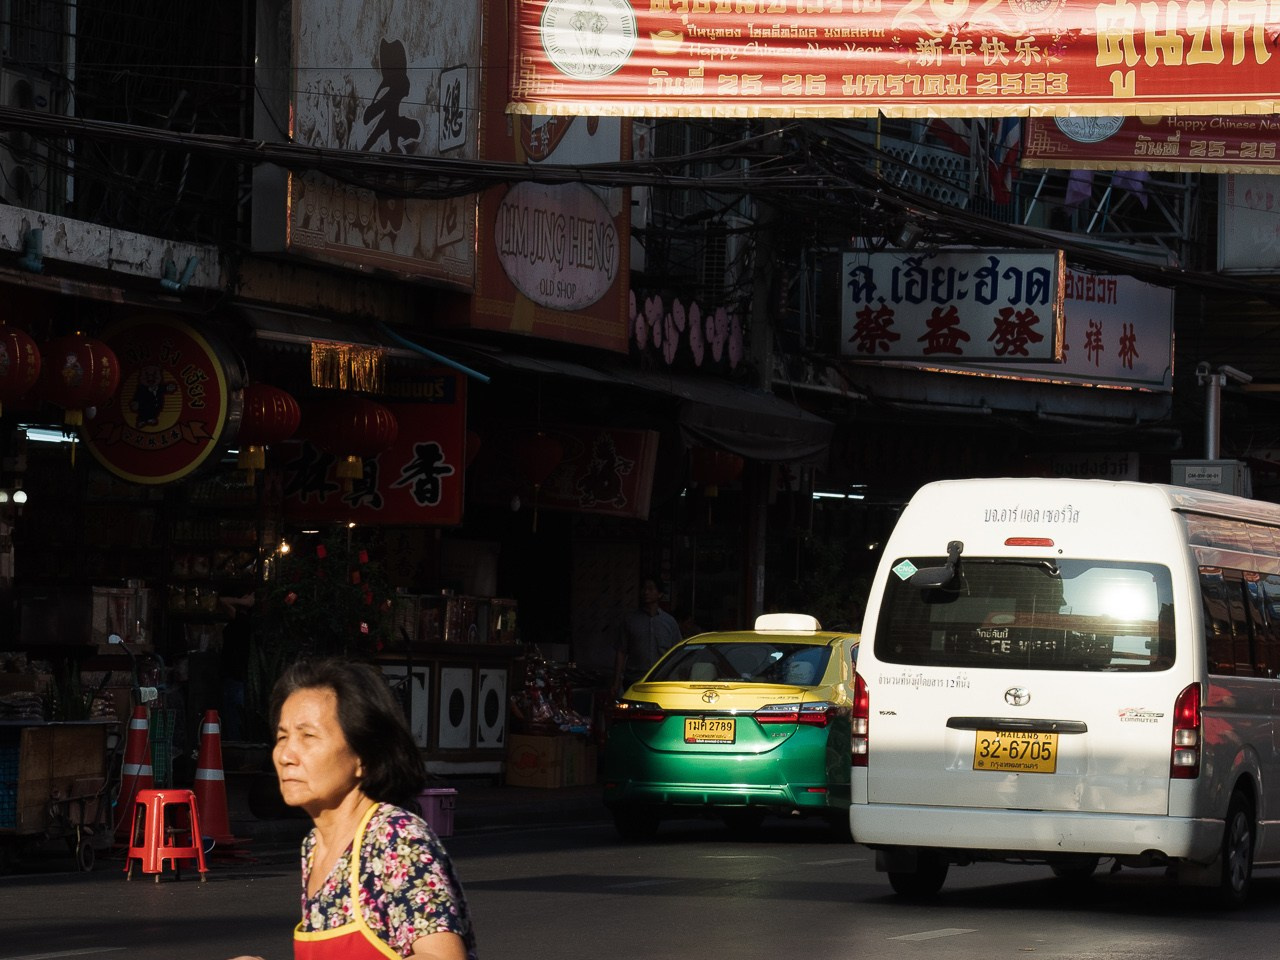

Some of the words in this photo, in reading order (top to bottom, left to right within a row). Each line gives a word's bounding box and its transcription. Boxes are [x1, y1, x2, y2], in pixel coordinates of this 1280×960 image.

[689, 43, 738, 60] Happy
[741, 42, 803, 57] Chinese
[806, 43, 842, 58] New
[844, 43, 883, 58] Year
[915, 36, 1041, 67] 新年快乐
[648, 60, 705, 97] วันที่
[717, 74, 827, 96] 25-26
[841, 74, 968, 96] มกราคม
[976, 73, 1069, 95] 2563
[1167, 116, 1207, 131] Happy
[1212, 117, 1256, 131] Chinese
[1133, 130, 1181, 156] วันที่
[1188, 140, 1276, 159] 25-26
[501, 202, 529, 258] LIM
[529, 208, 566, 272] JING
[572, 215, 616, 281] HIENG
[539, 278, 555, 297] OLD
[556, 280, 578, 301] SHOP
[709, 721, 733, 731] 2789
[979, 739, 1053, 760] 32-6705
